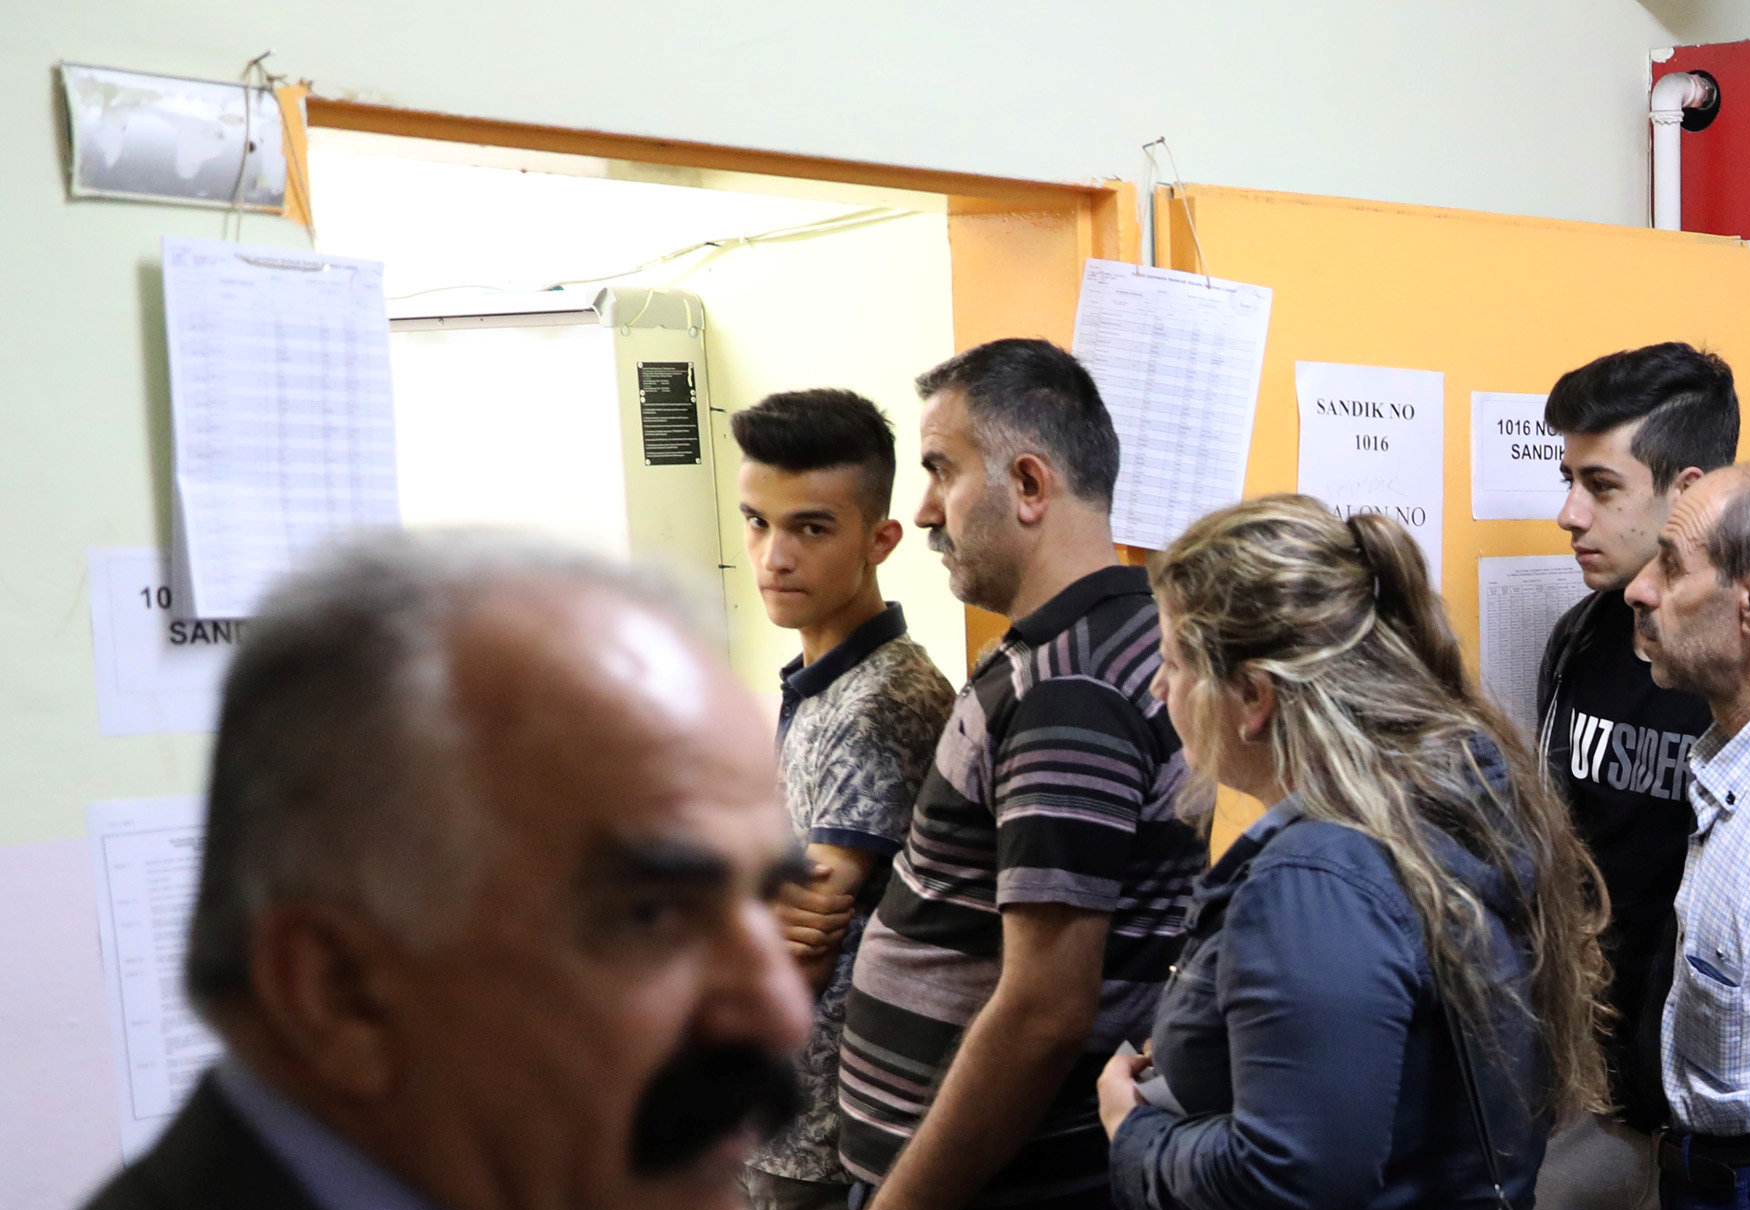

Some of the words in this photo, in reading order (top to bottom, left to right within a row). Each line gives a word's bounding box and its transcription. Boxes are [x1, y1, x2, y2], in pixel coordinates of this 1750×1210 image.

[1316, 398, 1384, 419] SANDIK
[1390, 403, 1415, 421] NO
[1497, 419, 1531, 436] 1016
[1536, 420, 1563, 437] NO
[1355, 434, 1389, 452] 1016
[1395, 506, 1427, 527] NO
[140, 586, 173, 610] 10
[169, 621, 241, 646] SAN
